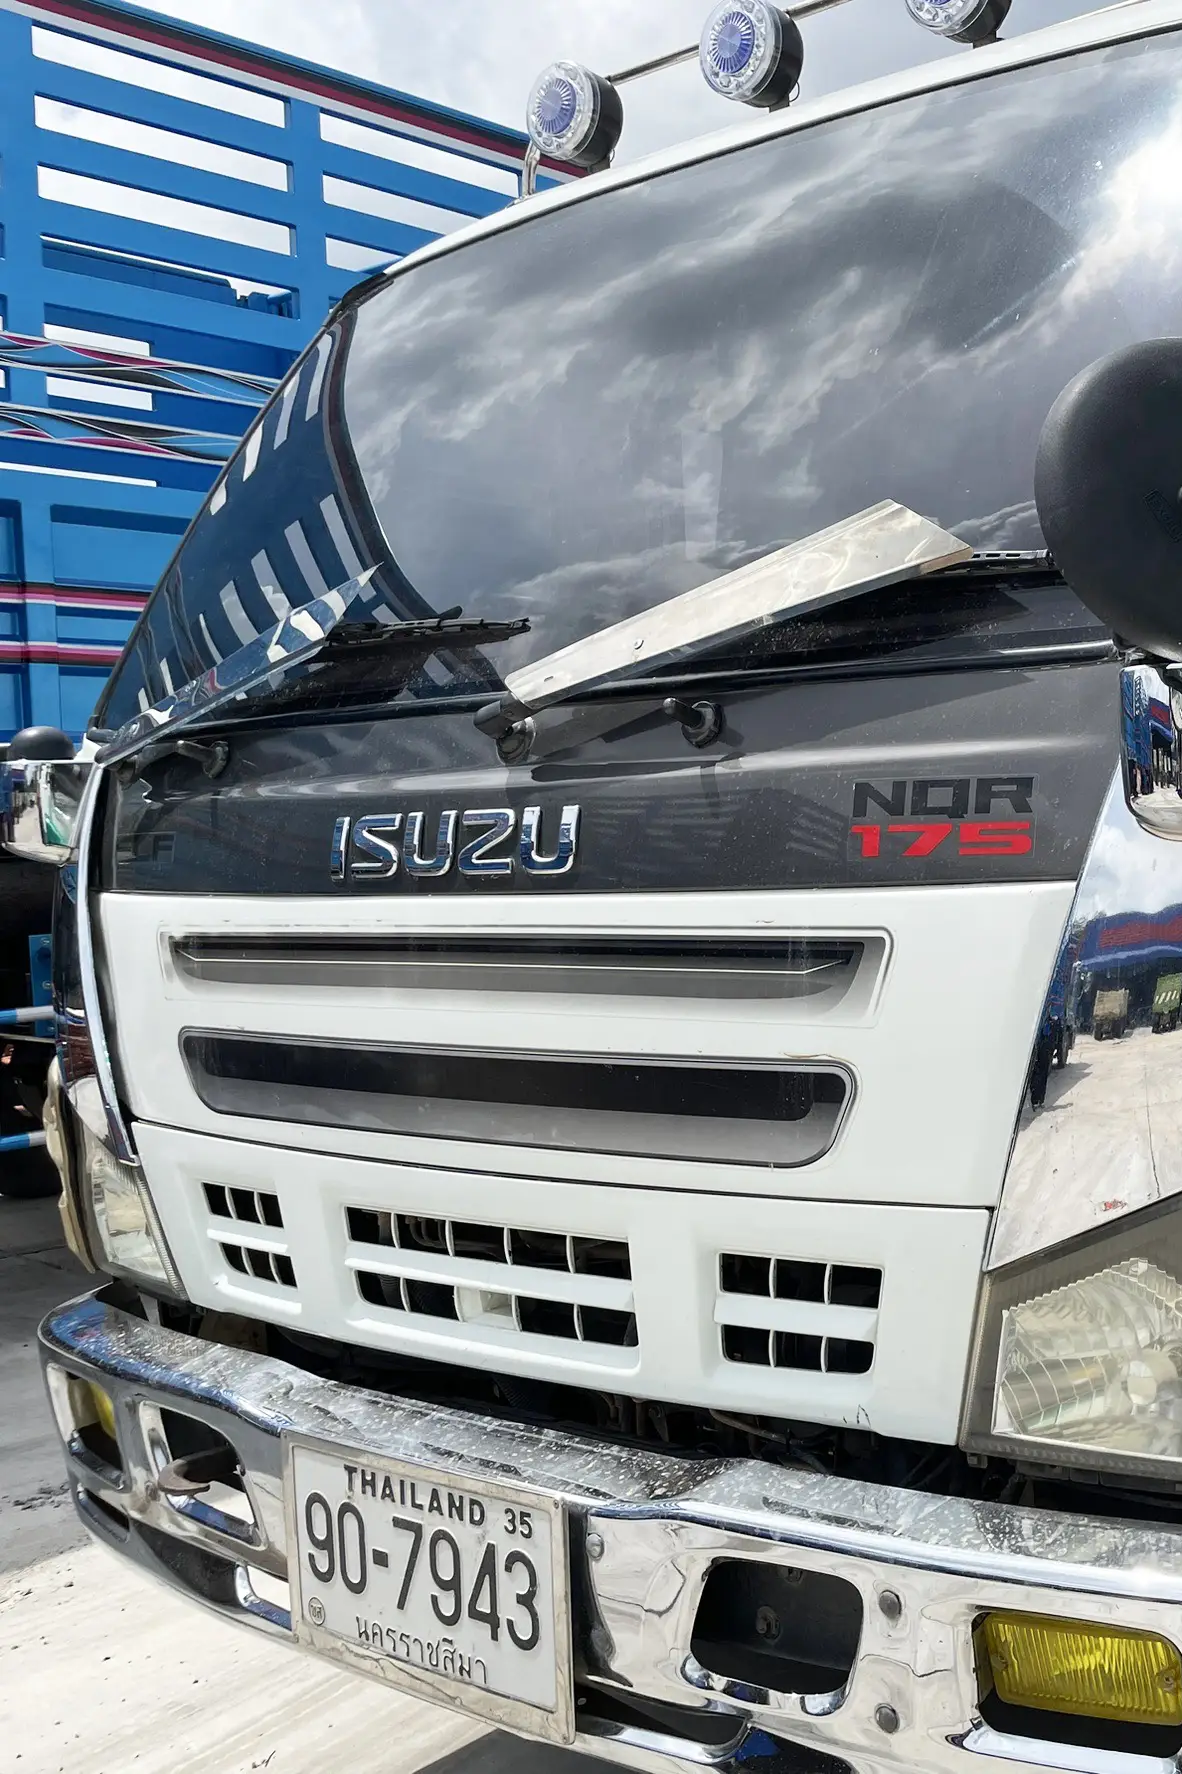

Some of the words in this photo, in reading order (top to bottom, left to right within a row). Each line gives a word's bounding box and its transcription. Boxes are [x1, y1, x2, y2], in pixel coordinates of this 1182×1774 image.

[852, 776, 1034, 819] NQR
[329, 804, 582, 882] ISUZU
[851, 820, 1033, 858] 175
[343, 1463, 486, 1527] THAILAND
[503, 1507, 533, 1540] 35
[304, 1491, 540, 1652] 90-7943
[355, 1615, 488, 1685] นครราชสีมา
